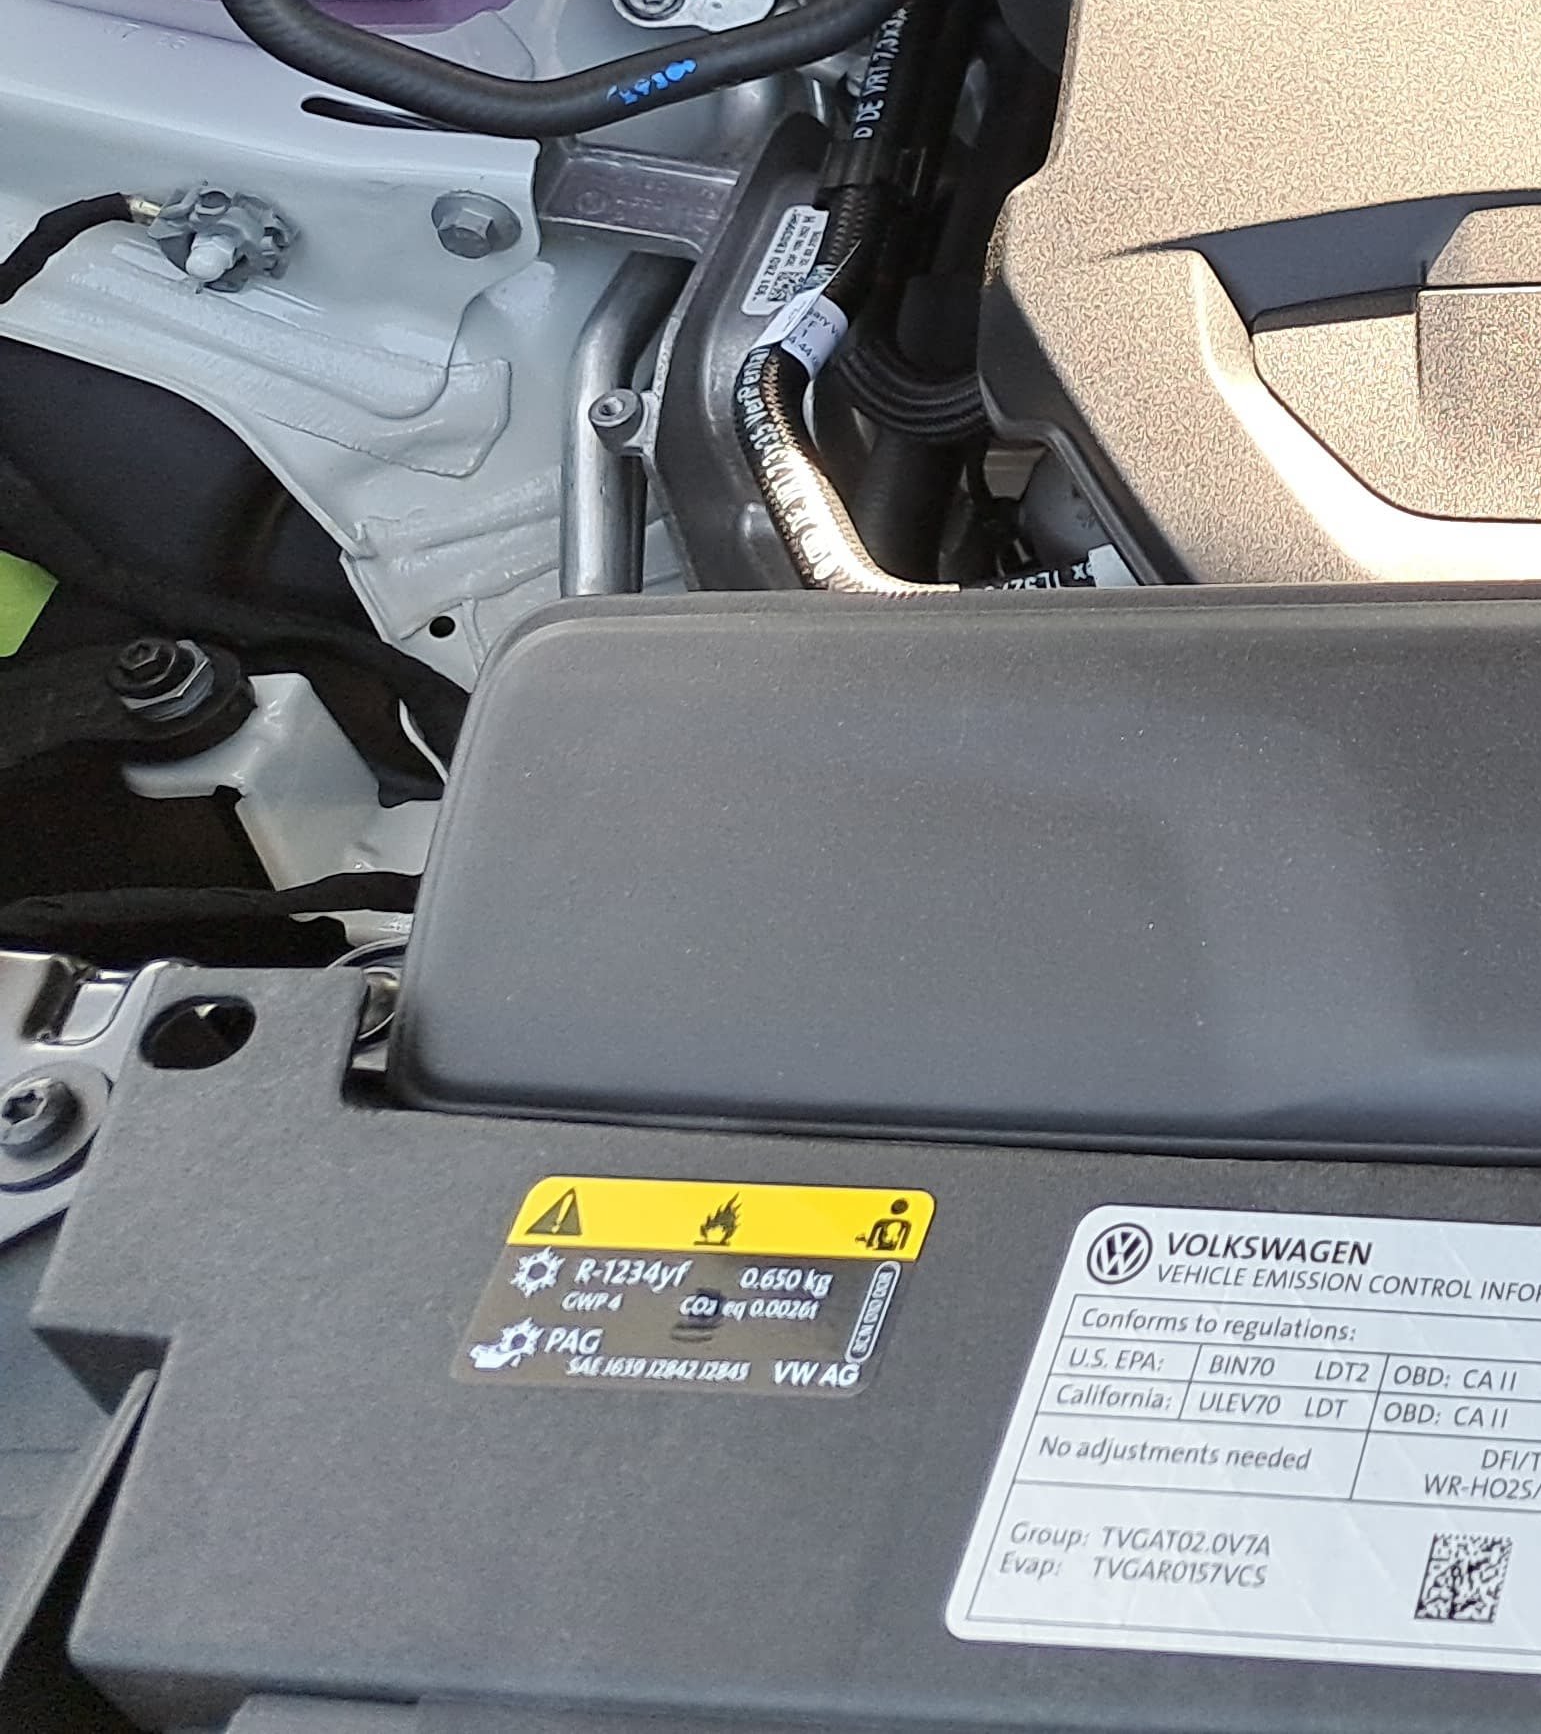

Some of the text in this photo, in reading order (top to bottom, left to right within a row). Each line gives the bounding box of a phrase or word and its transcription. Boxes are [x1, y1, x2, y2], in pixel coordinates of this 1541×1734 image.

[1167, 1231, 1373, 1266] VOLKSWAGEN
[573, 1257, 693, 1293] R-1234yf
[1157, 1263, 1247, 1286] VEHICLE
[1251, 1267, 1363, 1293] EMISSION
[1367, 1274, 1472, 1300] CONTROL
[1081, 1307, 1356, 1342] Conforms to regulations:
[542, 1326, 604, 1355] PAG
[1067, 1346, 1164, 1371] U.S. EPA:
[1207, 1353, 1276, 1377] BIN70
[1313, 1359, 1370, 1383] LDT2
[773, 1359, 860, 1387] VW AG
[1392, 1364, 1450, 1388] OBD:
[1462, 1368, 1493, 1390] CA
[1055, 1383, 1172, 1411] California:
[1198, 1391, 1281, 1416] ULEV70
[1303, 1395, 1348, 1419] LDT
[1382, 1400, 1441, 1425] OBD:
[1452, 1405, 1484, 1427] CA
[1038, 1435, 1313, 1471] No adjustments needed
[1009, 1520, 1090, 1553] Group:
[998, 1550, 1062, 1581] Evap:
